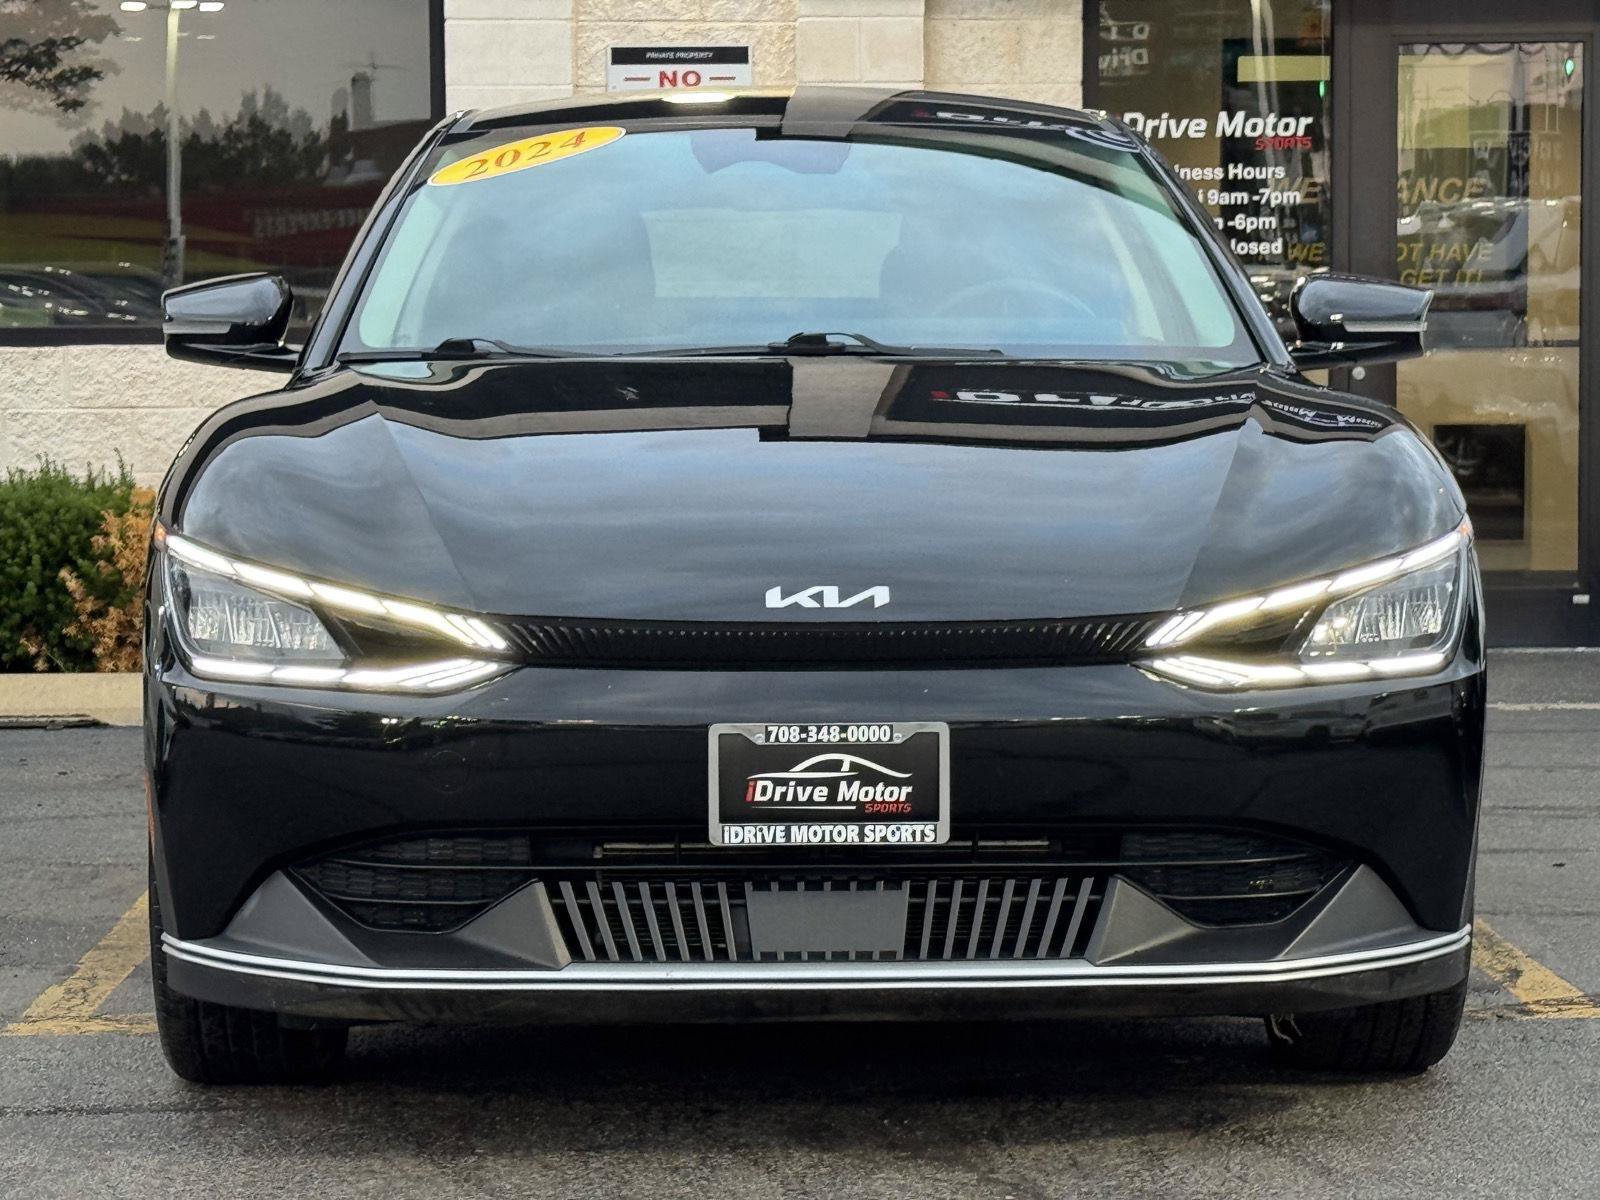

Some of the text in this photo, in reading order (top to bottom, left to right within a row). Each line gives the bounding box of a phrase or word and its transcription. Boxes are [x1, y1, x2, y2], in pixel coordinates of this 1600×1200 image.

[659, 70, 701, 88] NO
[1115, 110, 1314, 139] Drive Motor
[1254, 136, 1312, 151] SPORTS
[464, 131, 586, 179] 2024
[1228, 162, 1286, 181] Hours
[1207, 188, 1249, 206] 9am
[1252, 187, 1301, 208] -7pm
[1227, 213, 1277, 234] -6pm
[1230, 237, 1283, 256] losed
[1397, 242, 1494, 262] OT HAVE
[1401, 268, 1450, 287] GET
[765, 585, 890, 609] KIA
[767, 725, 891, 743] 708-348-0000
[744, 779, 913, 802] iDrive Motor
[864, 802, 913, 814] SPORTS
[790, 825, 860, 844] MOTOR
[864, 824, 936, 843] SPORTS
